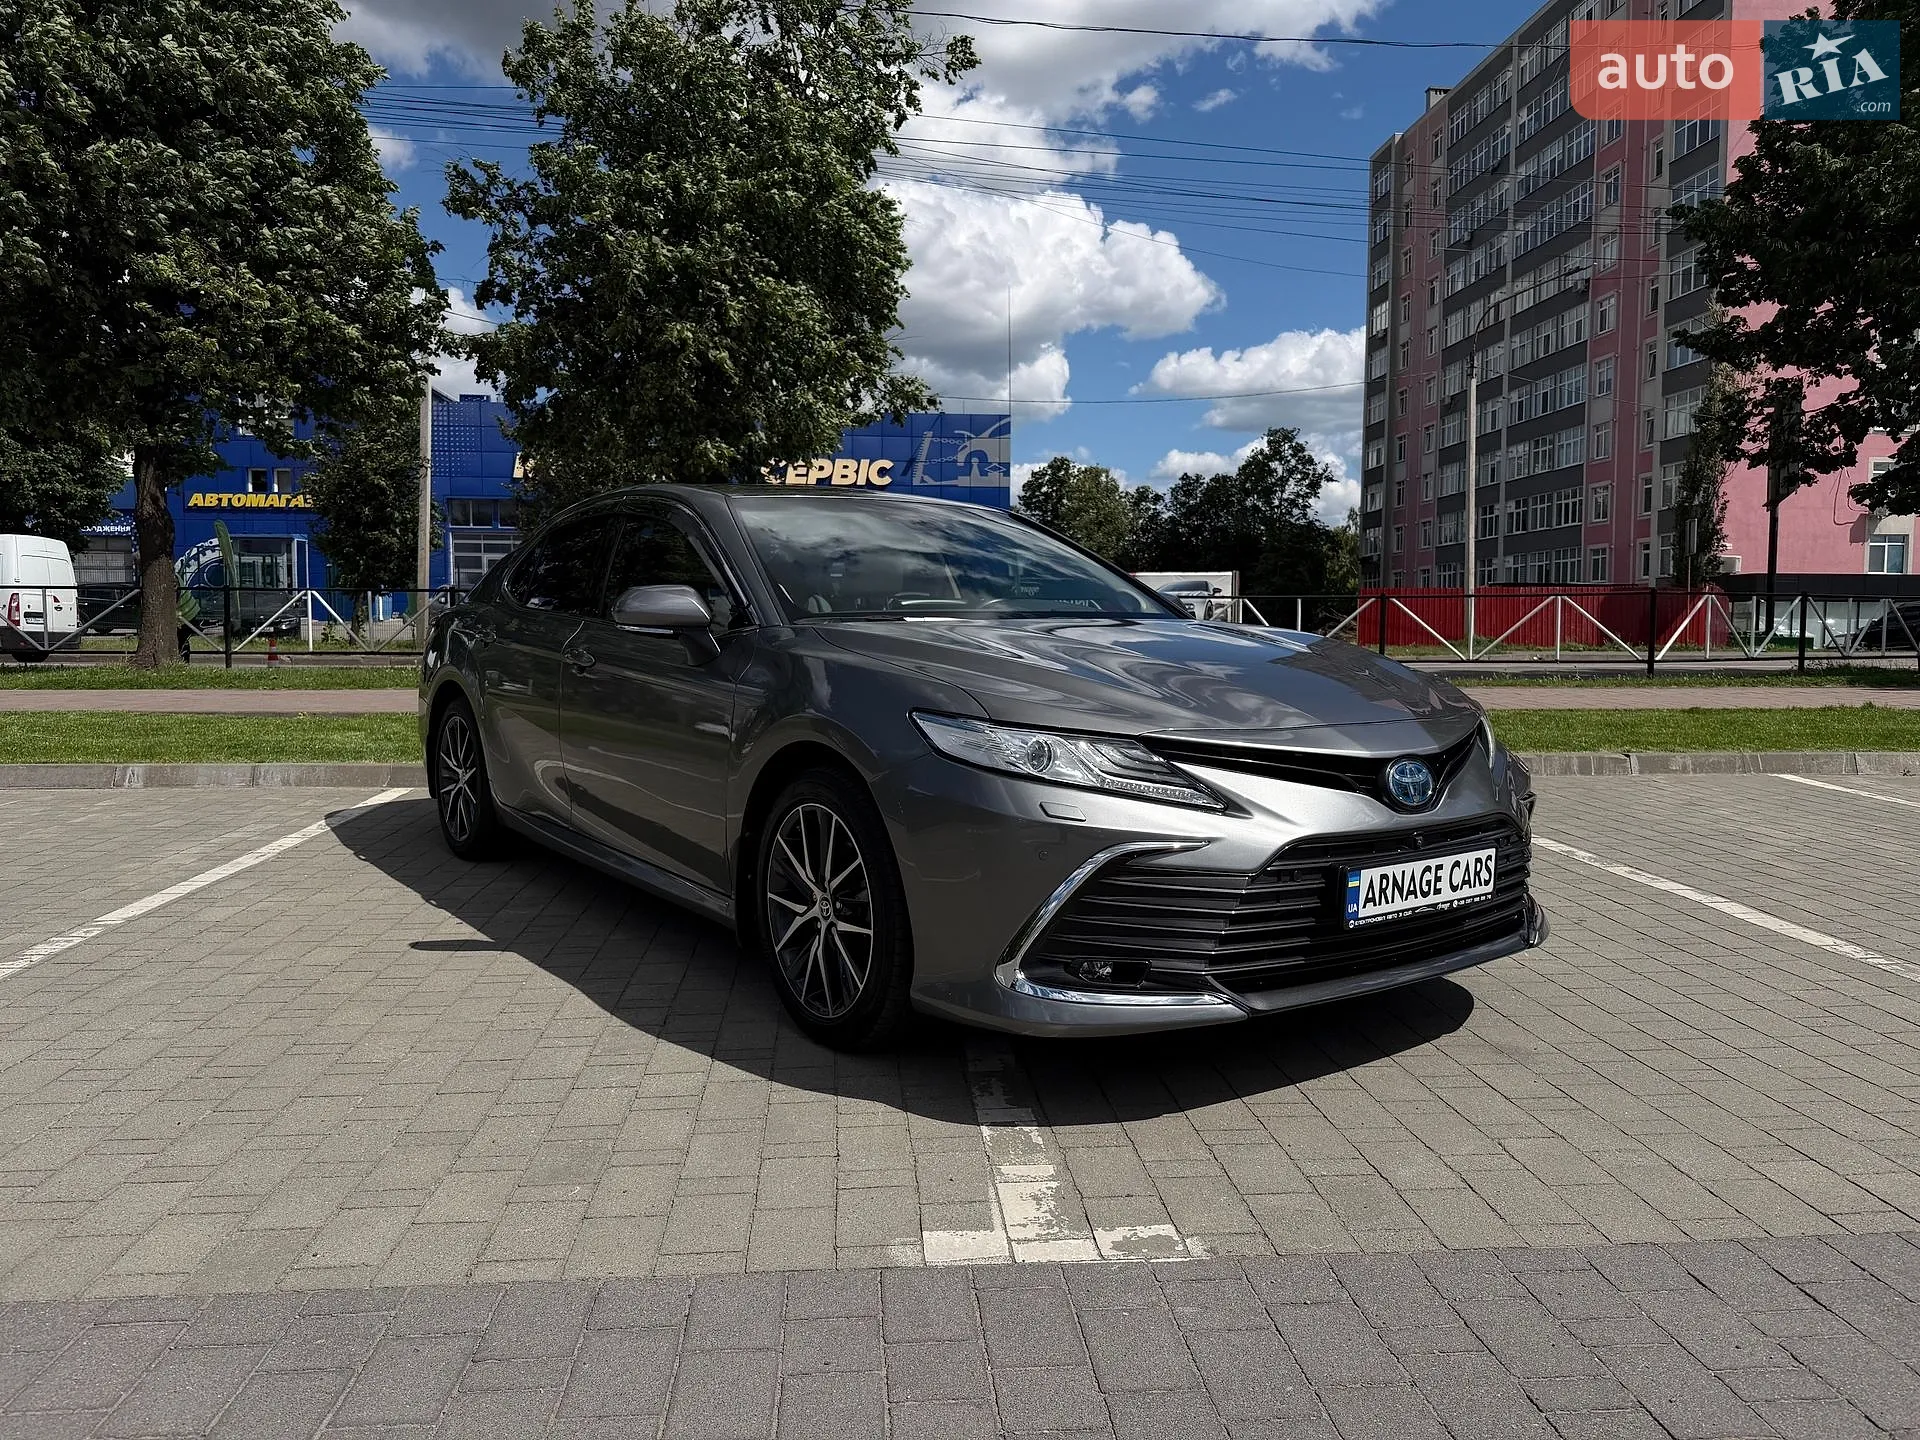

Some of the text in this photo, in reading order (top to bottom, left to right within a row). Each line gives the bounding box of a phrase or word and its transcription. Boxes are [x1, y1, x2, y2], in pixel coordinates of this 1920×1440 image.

[1362, 854, 1493, 909] ARNAGE CARS
[1348, 903, 1358, 913] UA
